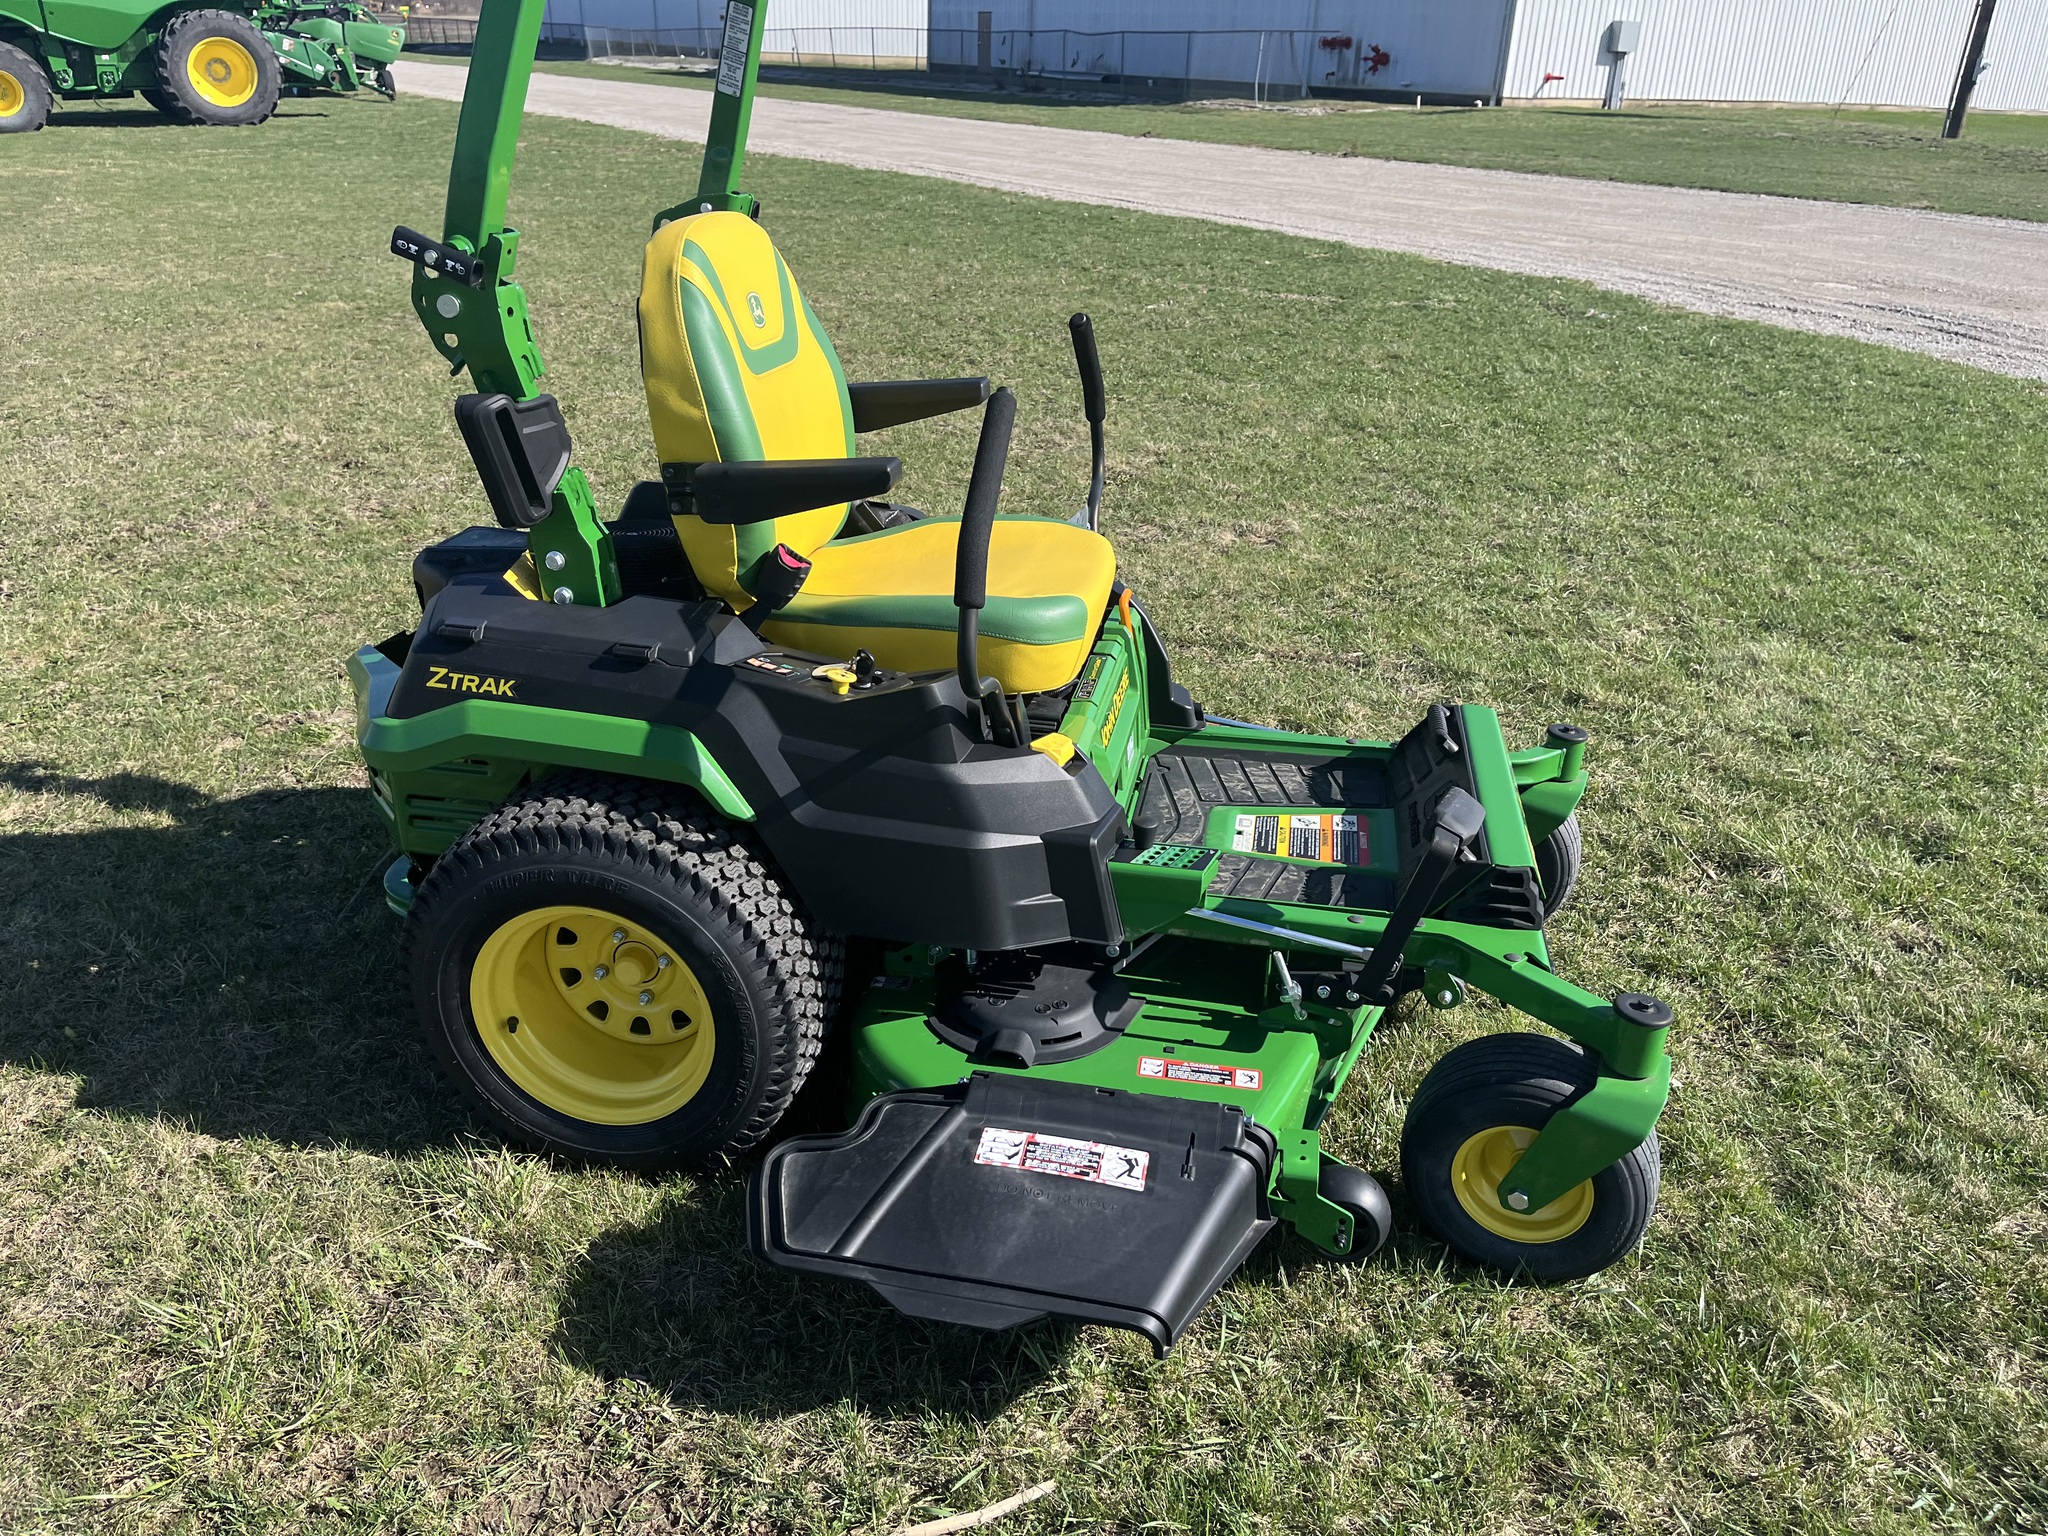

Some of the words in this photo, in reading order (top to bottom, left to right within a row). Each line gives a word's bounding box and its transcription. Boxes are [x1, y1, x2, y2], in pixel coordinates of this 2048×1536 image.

[426, 666, 516, 697] ZTRAK
[1101, 706, 1115, 750] JOHN
[1113, 666, 1129, 718] DEERE
[1189, 1062, 1219, 1070] DANGER
